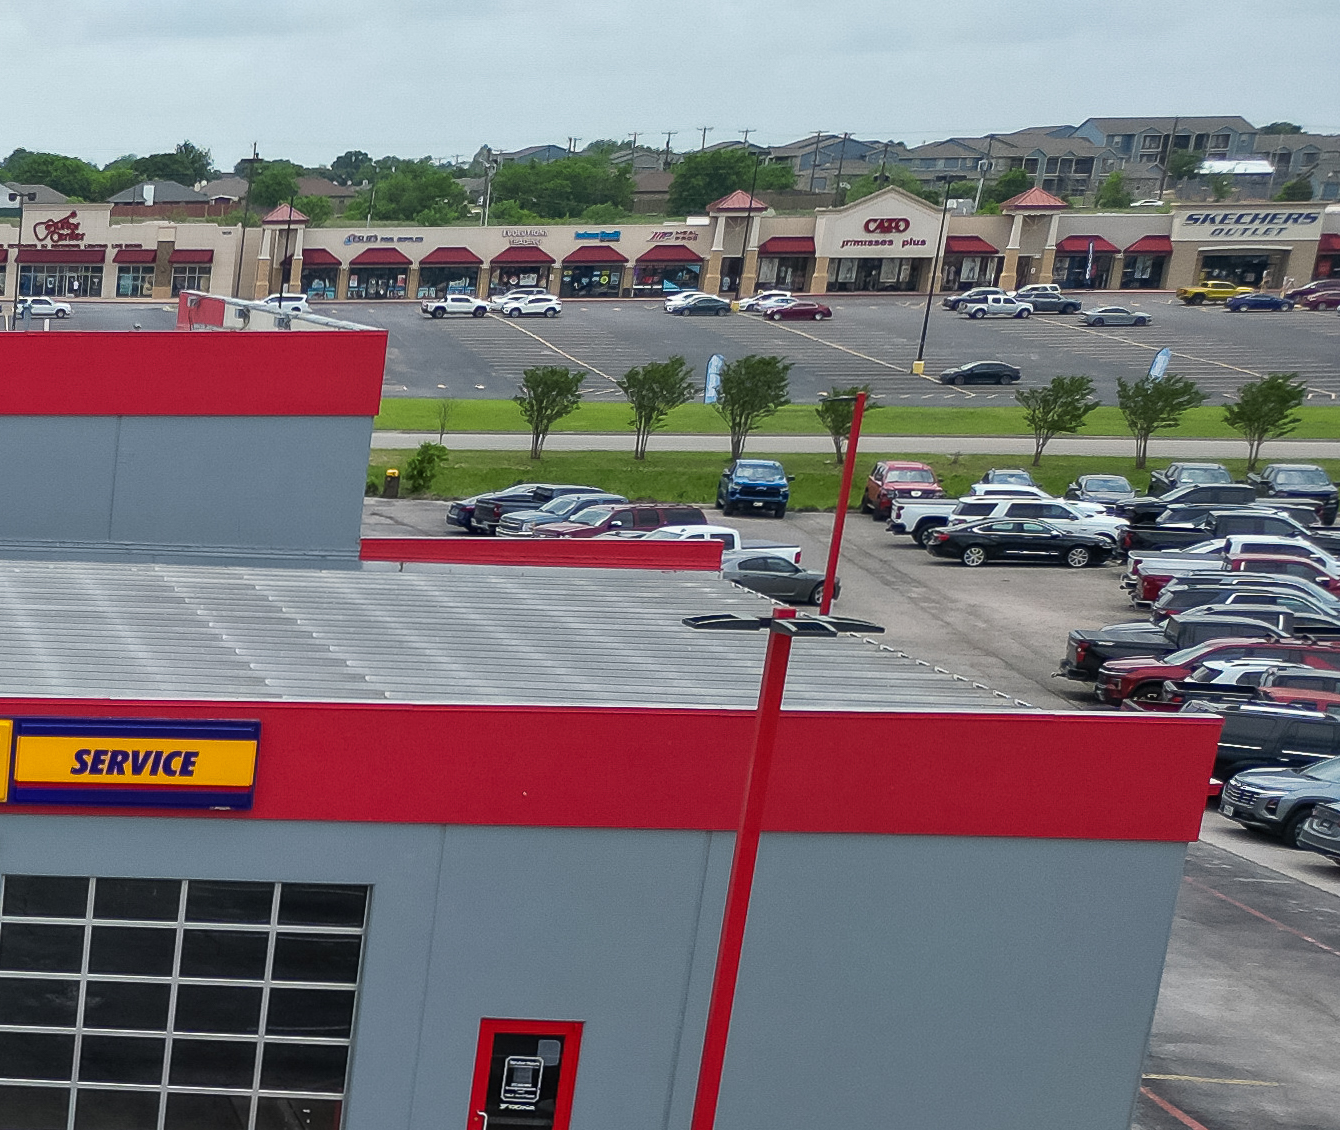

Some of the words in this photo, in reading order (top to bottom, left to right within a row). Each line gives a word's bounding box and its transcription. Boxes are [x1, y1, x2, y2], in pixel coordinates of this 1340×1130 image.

[1184, 212, 1320, 225] SKECHERS
[863, 217, 911, 234] CATO
[1209, 226, 1289, 237] OUTLET
[901, 237, 927, 248] plus
[70, 748, 200, 777] SERVICE
